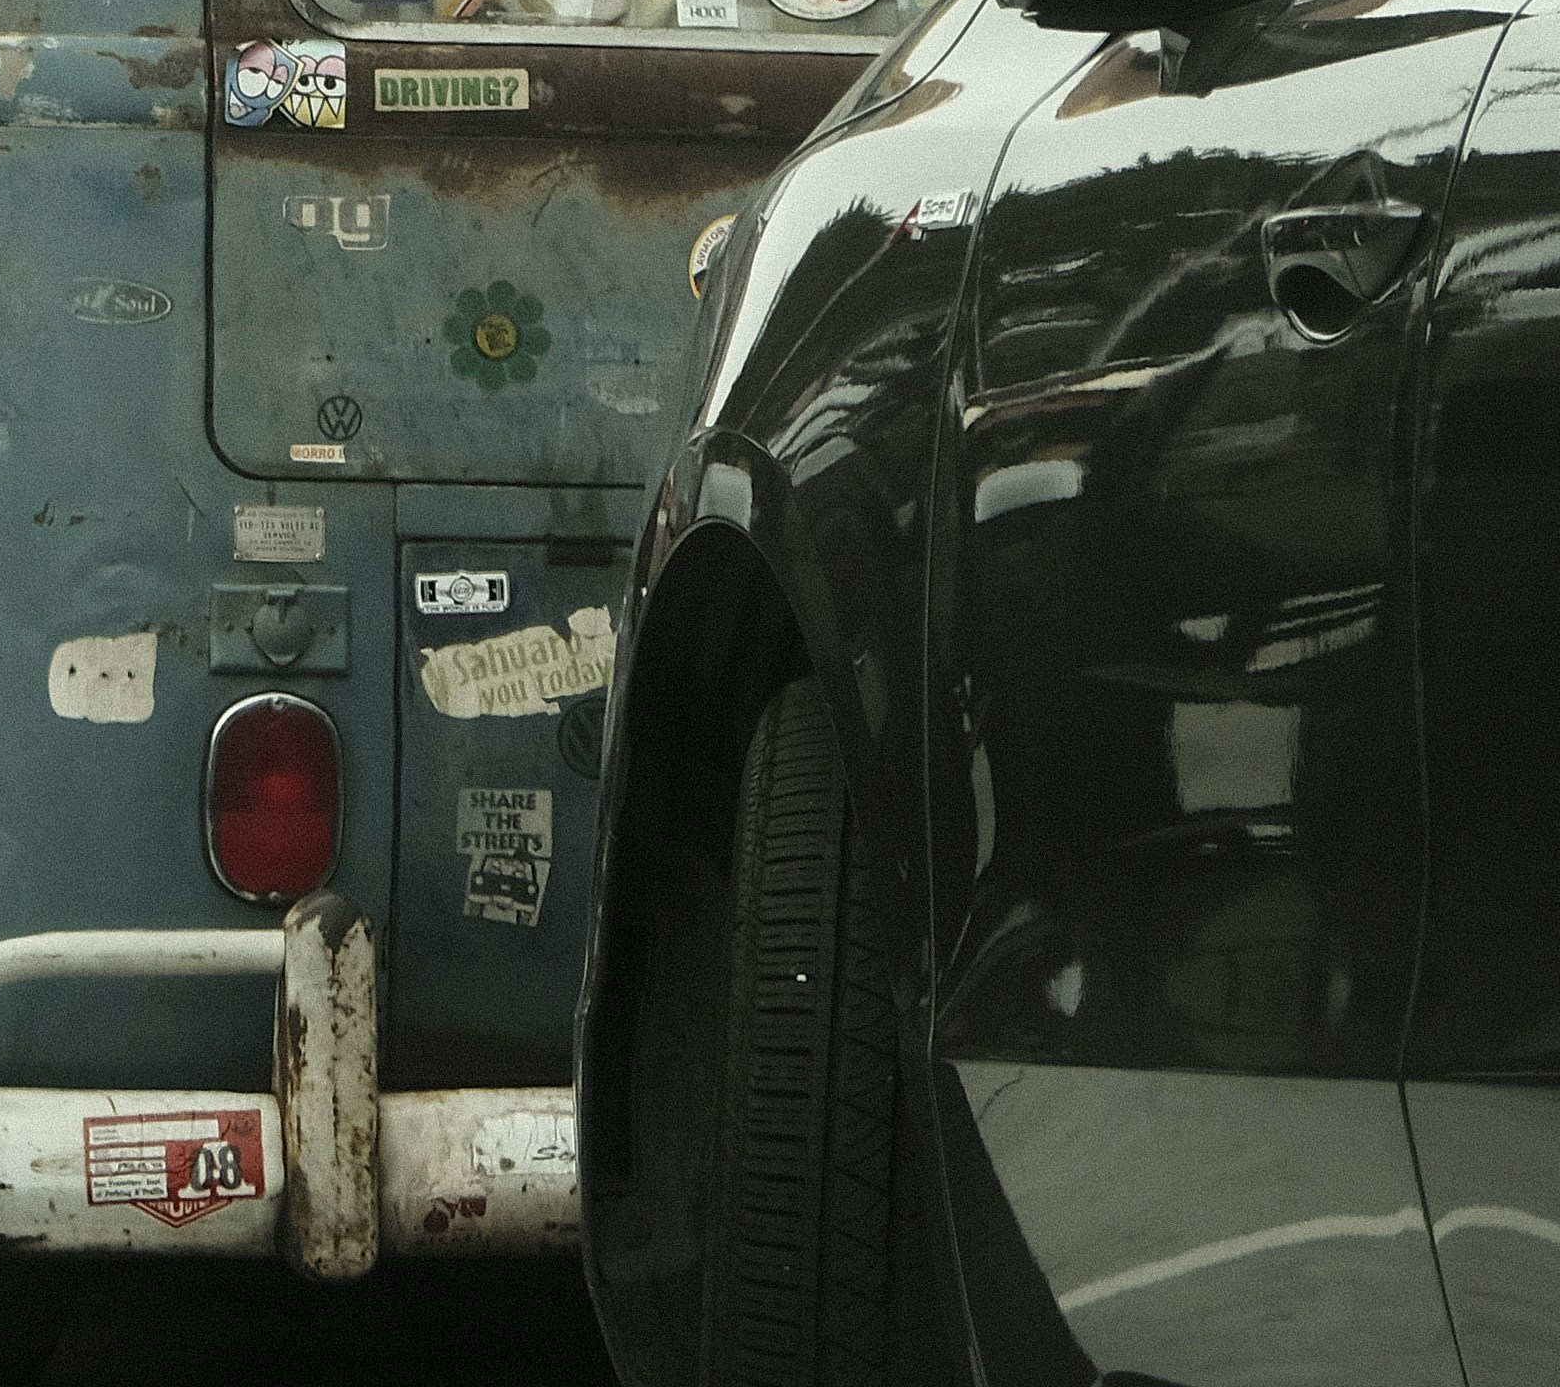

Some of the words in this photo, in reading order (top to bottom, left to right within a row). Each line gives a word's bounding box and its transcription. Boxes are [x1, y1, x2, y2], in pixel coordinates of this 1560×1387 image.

[379, 77, 520, 107] DRIVING?
[452, 631, 582, 686] Sahuaro
[481, 680, 528, 713] you
[537, 657, 611, 696] today
[470, 791, 536, 811] SHARE
[482, 811, 521, 830] THE
[461, 830, 542, 852] STREETS
[190, 1144, 244, 1192] 08
